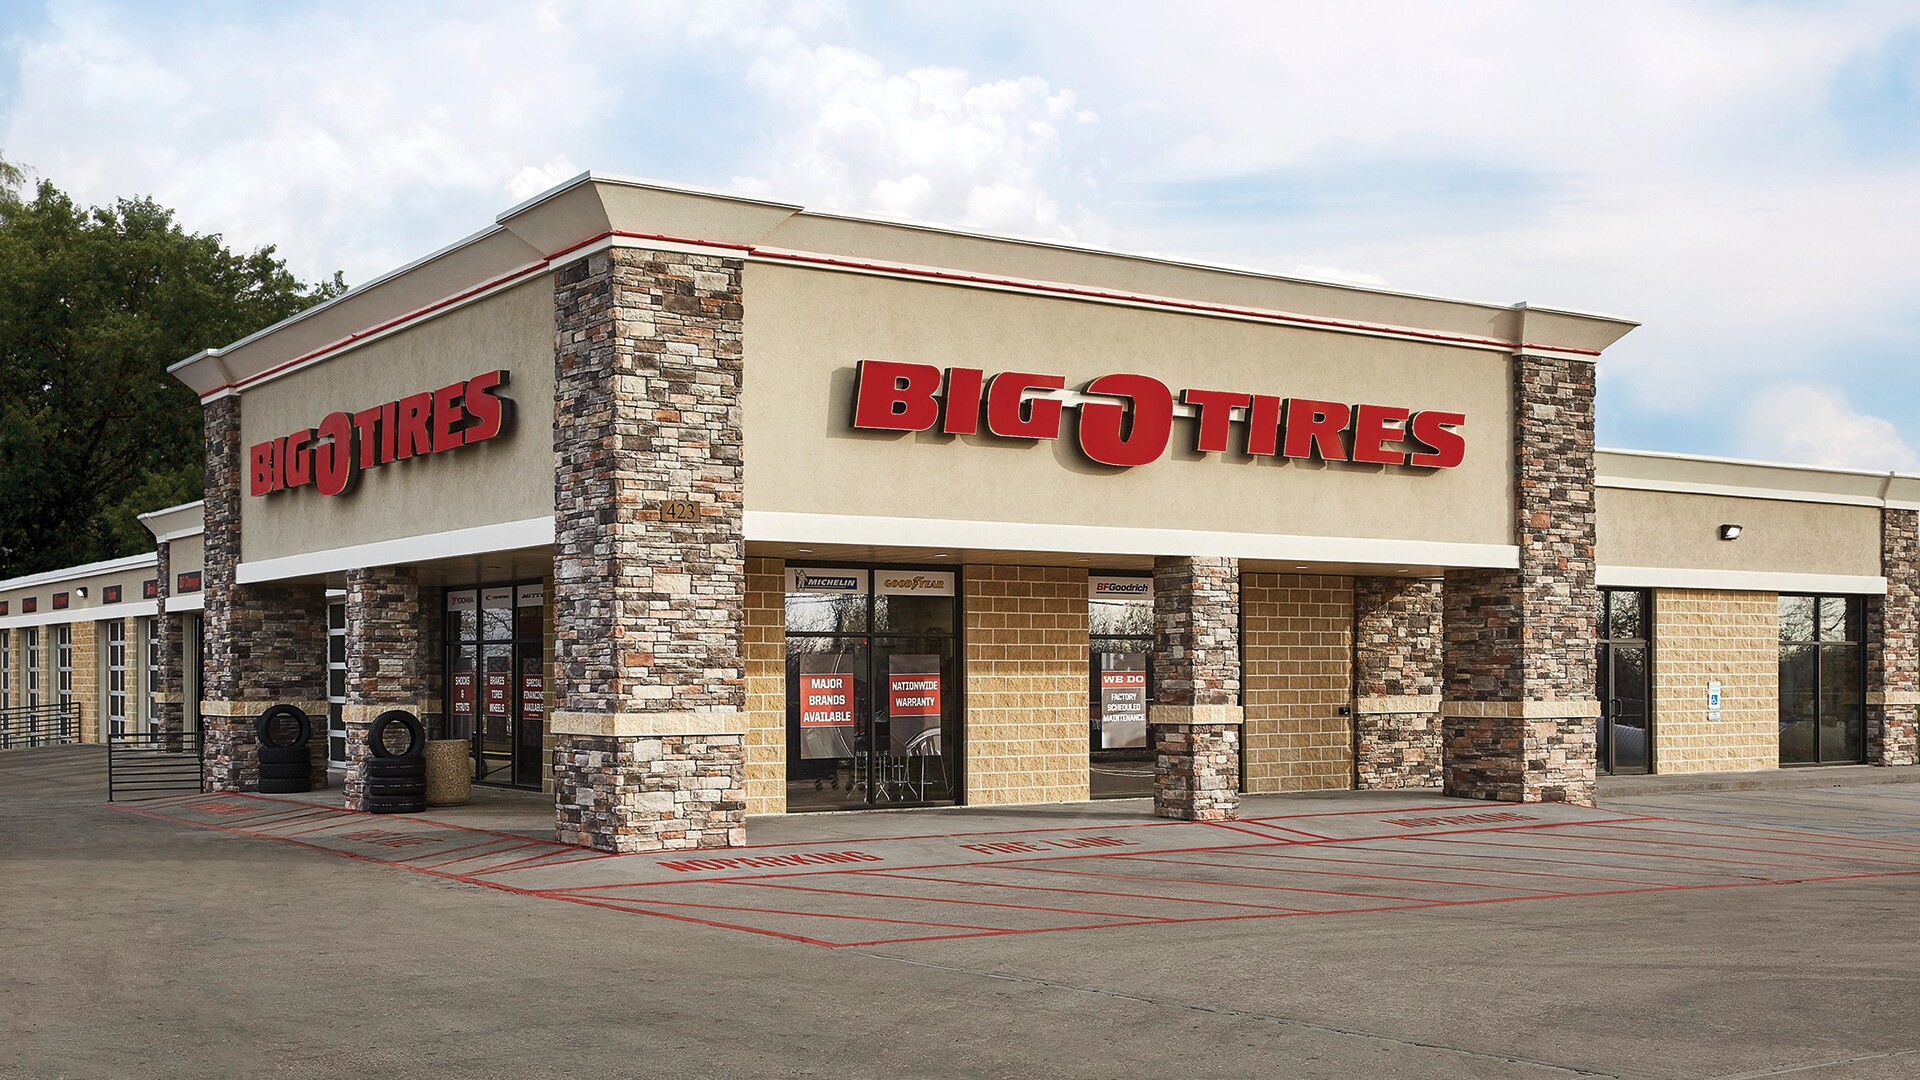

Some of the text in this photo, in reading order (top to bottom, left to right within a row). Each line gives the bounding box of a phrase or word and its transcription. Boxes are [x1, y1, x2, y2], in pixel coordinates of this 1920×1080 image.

[855, 359, 1467, 469] BIG O TIRES
[250, 369, 505, 497] BIG O TIRES
[666, 503, 695, 520] 423
[807, 577, 856, 587] MICHELIN
[883, 576, 944, 590] GOODYEAR
[1096, 583, 1148, 592] BFGoodrich
[455, 676, 470, 686] SHOCKS
[489, 676, 505, 685] BRAKES
[526, 679, 542, 687] SPECIAL
[811, 678, 843, 689] MAJOR
[1103, 675, 1145, 684] WE DO
[892, 681, 938, 691] NATIONWIDE
[491, 690, 503, 699] TIRES
[1110, 693, 1137, 701] FACTORY
[809, 695, 846, 706] BRANDS
[895, 697, 935, 707] WARRANTY
[455, 703, 470, 712] STRUTS
[489, 704, 505, 713] WHEELS
[1107, 703, 1141, 712] SCHEDULED
[803, 711, 851, 723] AVAILABLE
[1103, 713, 1146, 722] MAINTENANCE
[958, 835, 1142, 855] FIRE LANE
